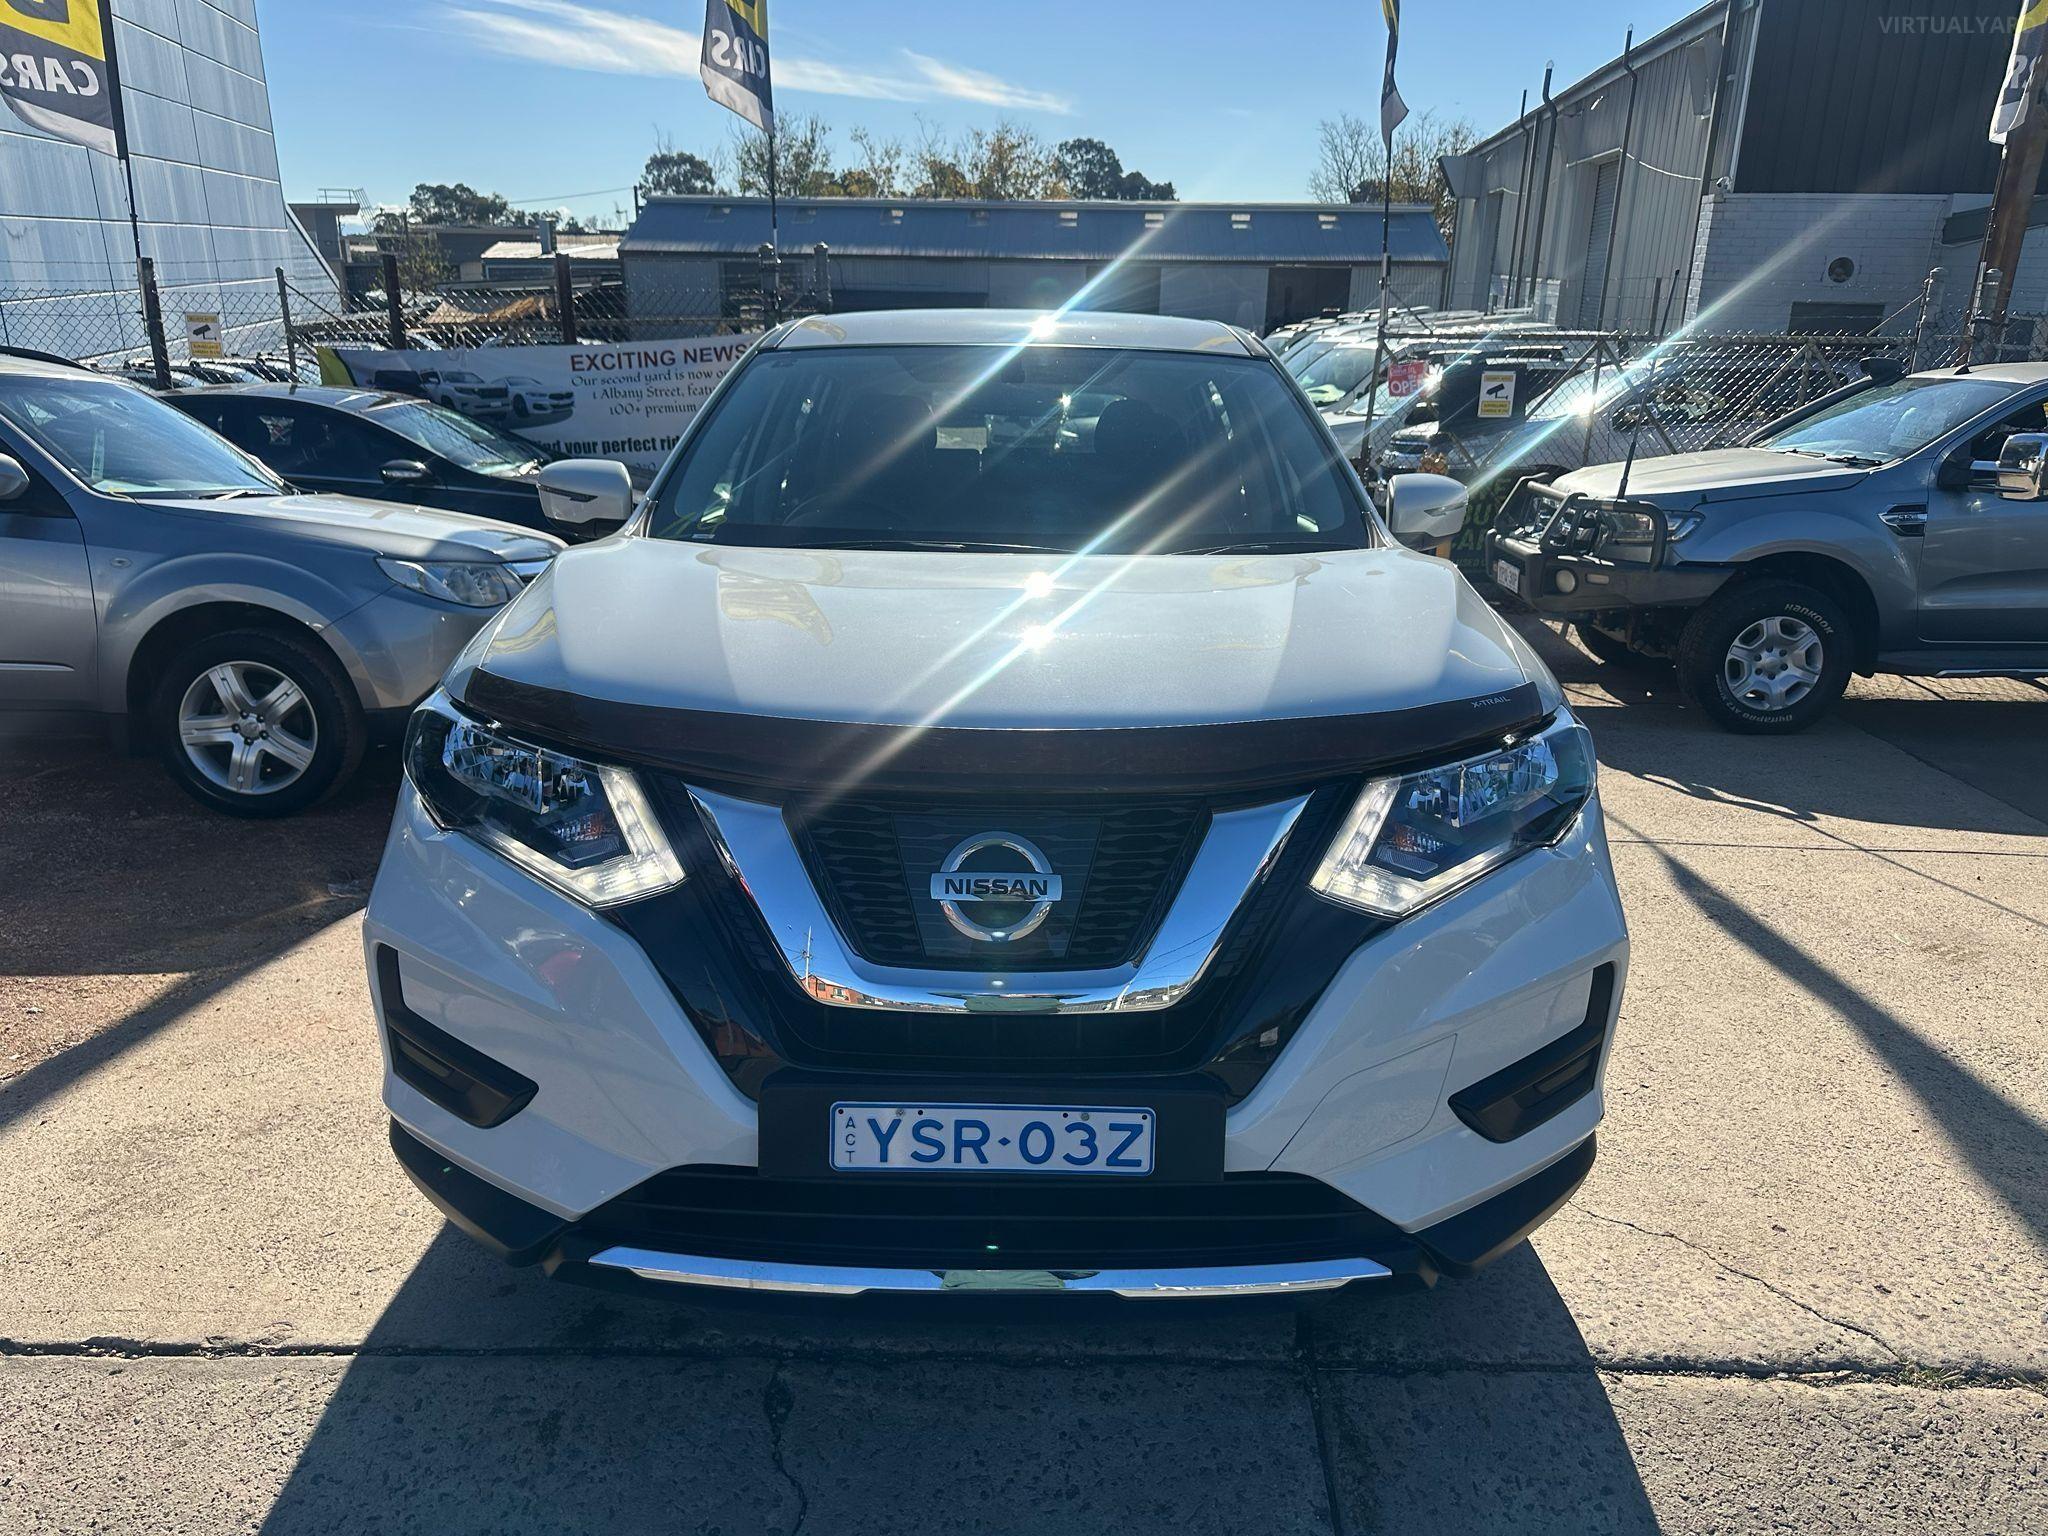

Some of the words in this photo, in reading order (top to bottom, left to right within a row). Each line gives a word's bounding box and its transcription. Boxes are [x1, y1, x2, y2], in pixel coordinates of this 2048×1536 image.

[570, 349, 677, 373] EXCITING
[683, 342, 753, 365] NEWS
[571, 375, 597, 387] Our
[600, 371, 641, 386] second
[644, 369, 672, 386] yard
[675, 368, 685, 381] is
[688, 369, 711, 380] now
[601, 386, 643, 403] Albany
[645, 400, 698, 418] premium
[564, 440, 599, 455] your
[602, 436, 657, 455] perfect
[1471, 695, 1511, 708] X-TRAIL
[944, 878, 1048, 896] NISSAN
